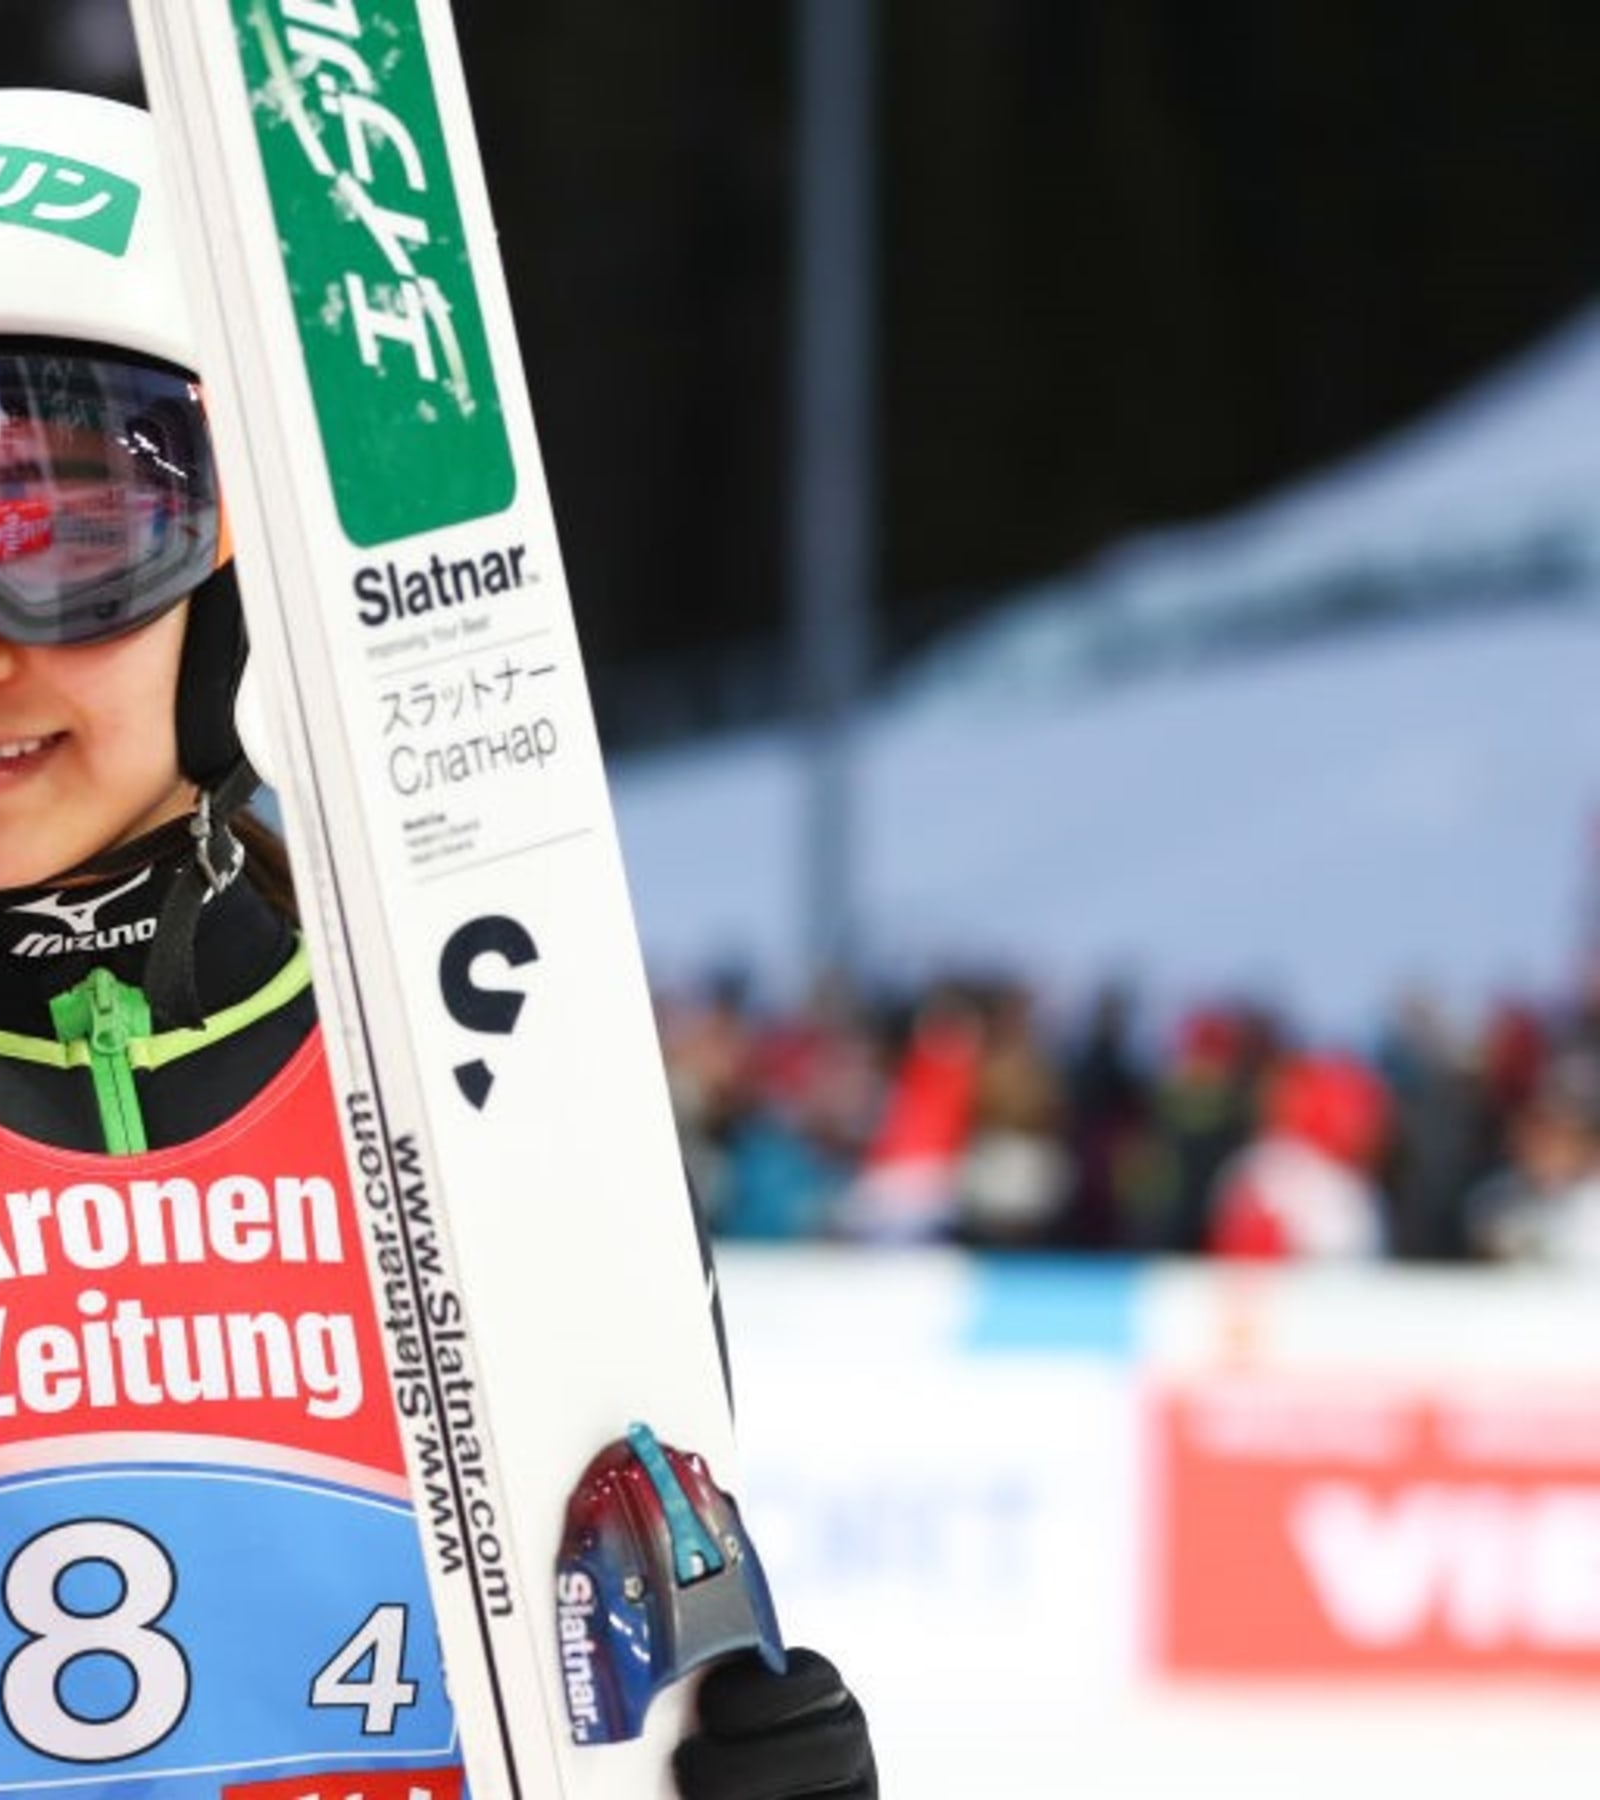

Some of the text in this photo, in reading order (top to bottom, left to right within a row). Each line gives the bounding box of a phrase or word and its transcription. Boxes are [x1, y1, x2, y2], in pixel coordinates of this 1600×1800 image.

[353, 545, 526, 627] Slatnar
[380, 659, 556, 735] スラットナー
[389, 717, 557, 796] Слатнар
[10, 917, 158, 958] MIZUNO
[346, 1090, 464, 1576] www.Slatnar.com
[393, 1133, 514, 1618] www.Slatnar.com
[307, 1602, 420, 1735] 4
[558, 1572, 598, 1724] Slatnar
